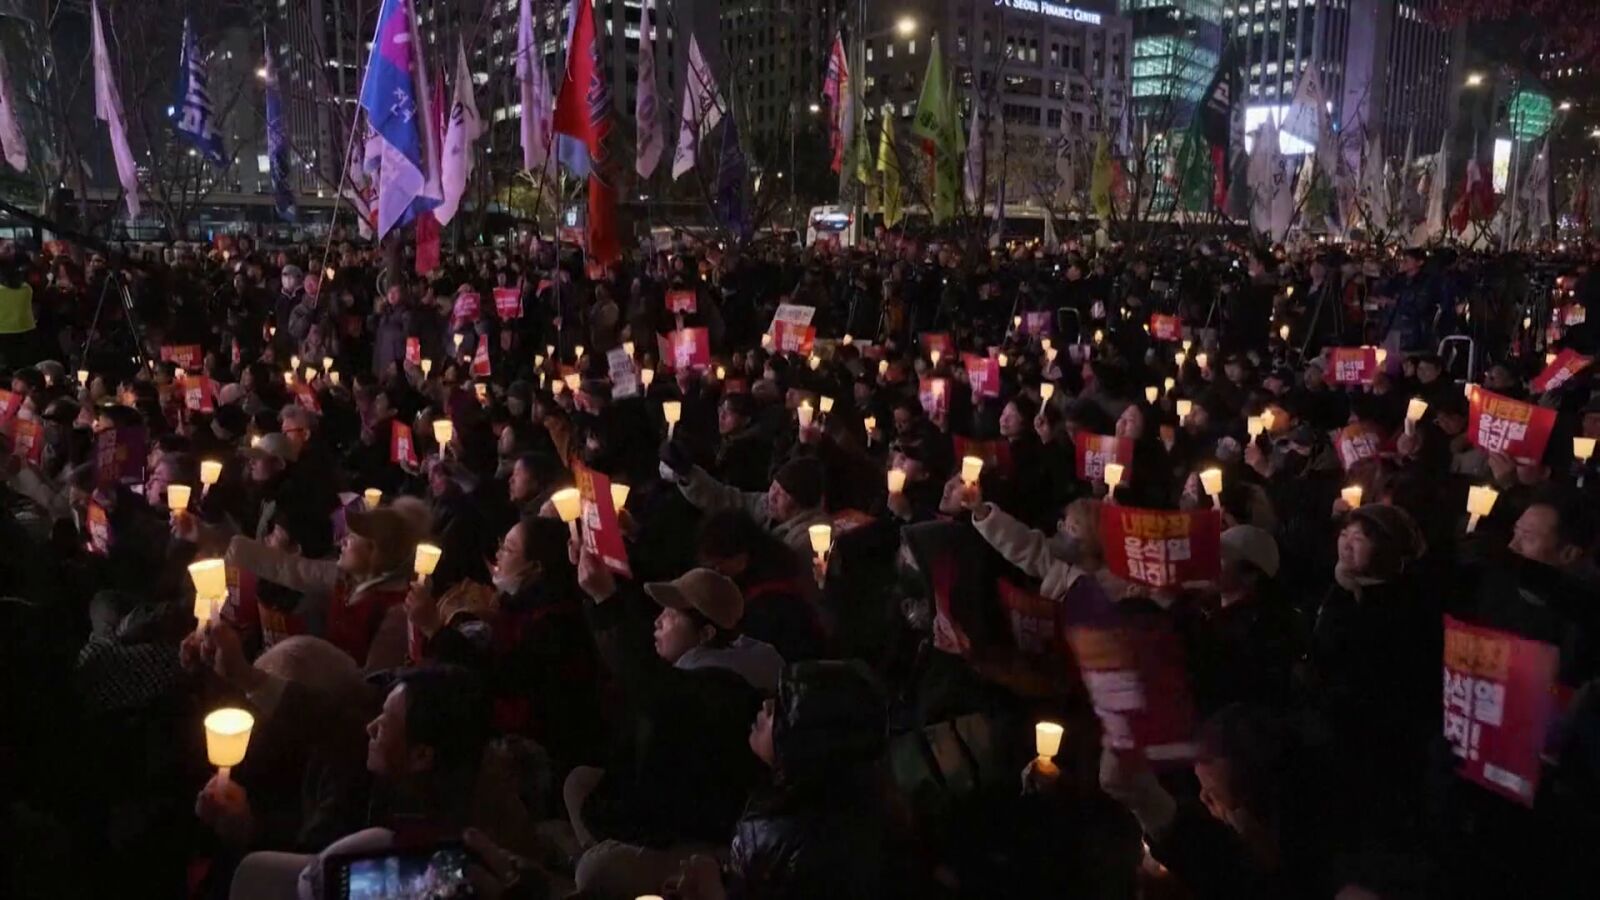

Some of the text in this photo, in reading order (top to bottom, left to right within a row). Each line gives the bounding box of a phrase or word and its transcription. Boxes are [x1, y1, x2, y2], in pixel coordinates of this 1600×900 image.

[1040, 2, 1074, 20] FINANCE
[1073, 8, 1101, 25] CENTER
[1479, 413, 1528, 441] 윤석열
[1478, 429, 1510, 454] 퇴진!
[1124, 536, 1191, 561] 윤석열
[1127, 558, 1176, 587] 퇴진!
